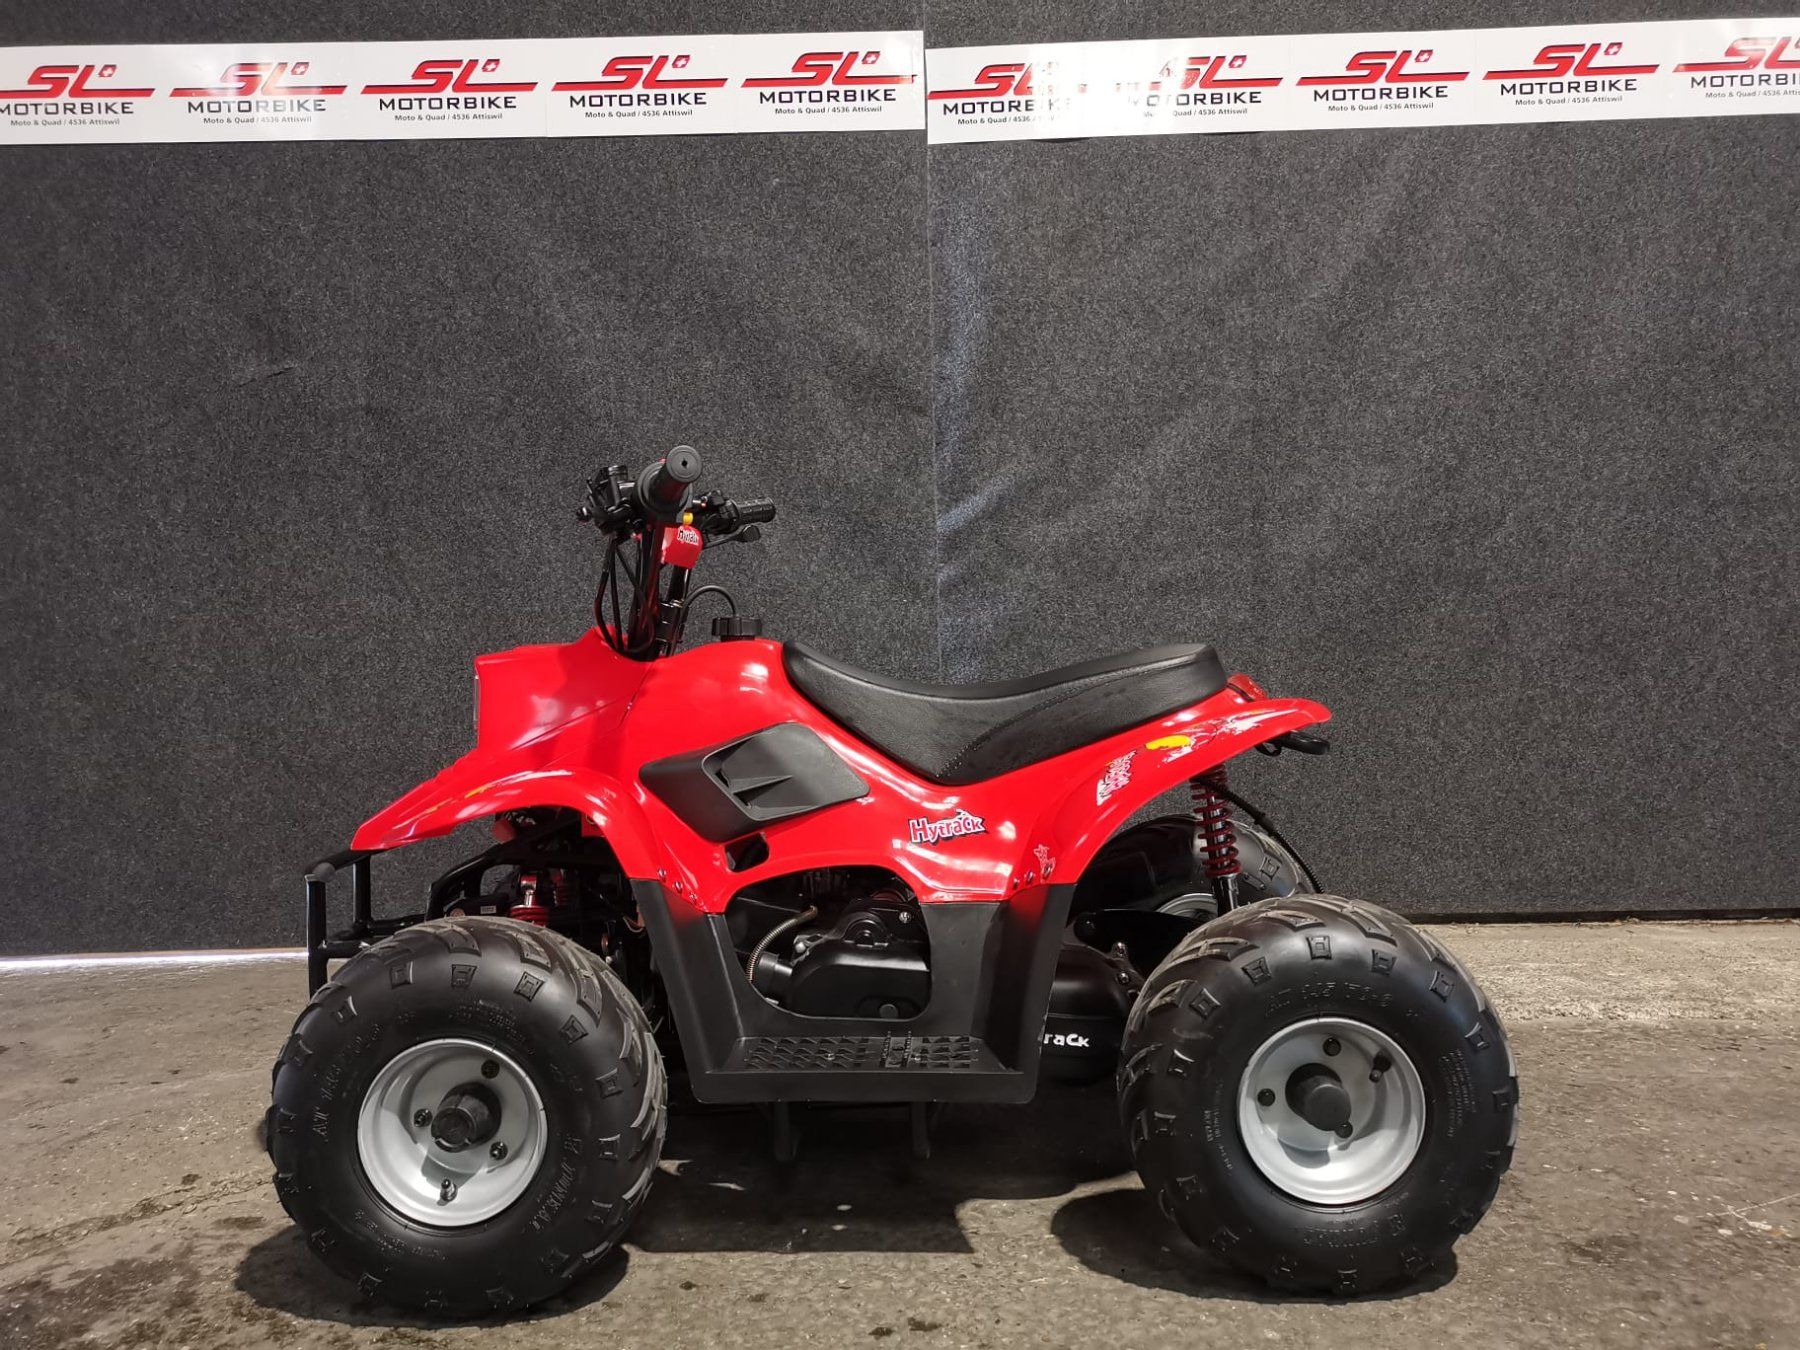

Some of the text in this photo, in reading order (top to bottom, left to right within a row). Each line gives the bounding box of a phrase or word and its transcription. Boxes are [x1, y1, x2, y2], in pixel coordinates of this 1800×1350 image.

[1314, 86, 1448, 101] MOTORBIKE
[1501, 79, 1637, 95] MOTORBIKE
[379, 96, 517, 111] MOTORBIKE
[570, 93, 707, 107] MOTORBIKE
[760, 89, 896, 104] MOTORBIKE
[188, 99, 326, 113] MOTORBIKE
[909, 812, 986, 844] Hytrack
